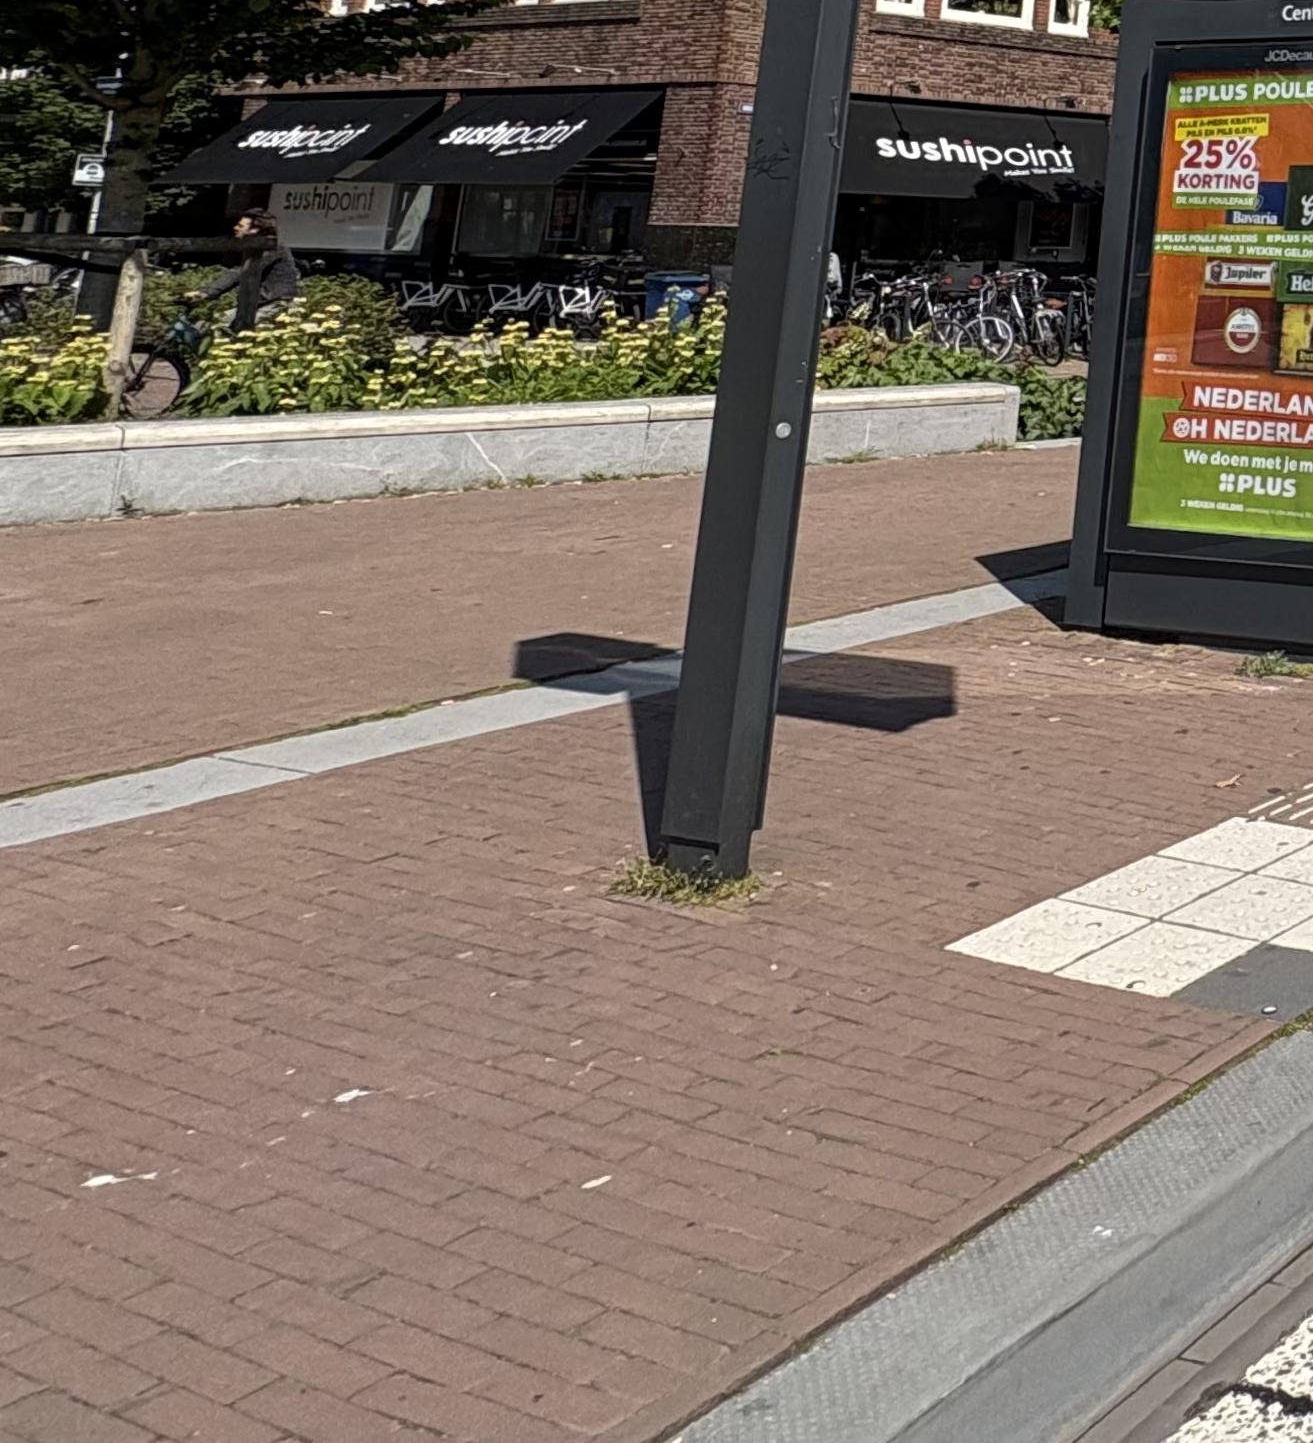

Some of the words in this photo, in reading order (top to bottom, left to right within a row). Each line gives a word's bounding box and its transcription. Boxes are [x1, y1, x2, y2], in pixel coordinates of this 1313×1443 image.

[1194, 83, 1248, 103] PLUS
[438, 119, 588, 152] sushipoint
[876, 137, 1073, 171] sushipoint
[1184, 139, 1253, 169] 25%
[1177, 173, 1255, 190] KORTING
[283, 185, 375, 218] sushipoint
[1232, 210, 1278, 225] Bavaria
[1224, 266, 1266, 280] Jupiler
[1183, 449, 1208, 465] We
[1210, 450, 1249, 468] doen
[1251, 454, 1281, 471] met
[1283, 455, 1298, 474] je
[1236, 474, 1297, 498] PLUS
